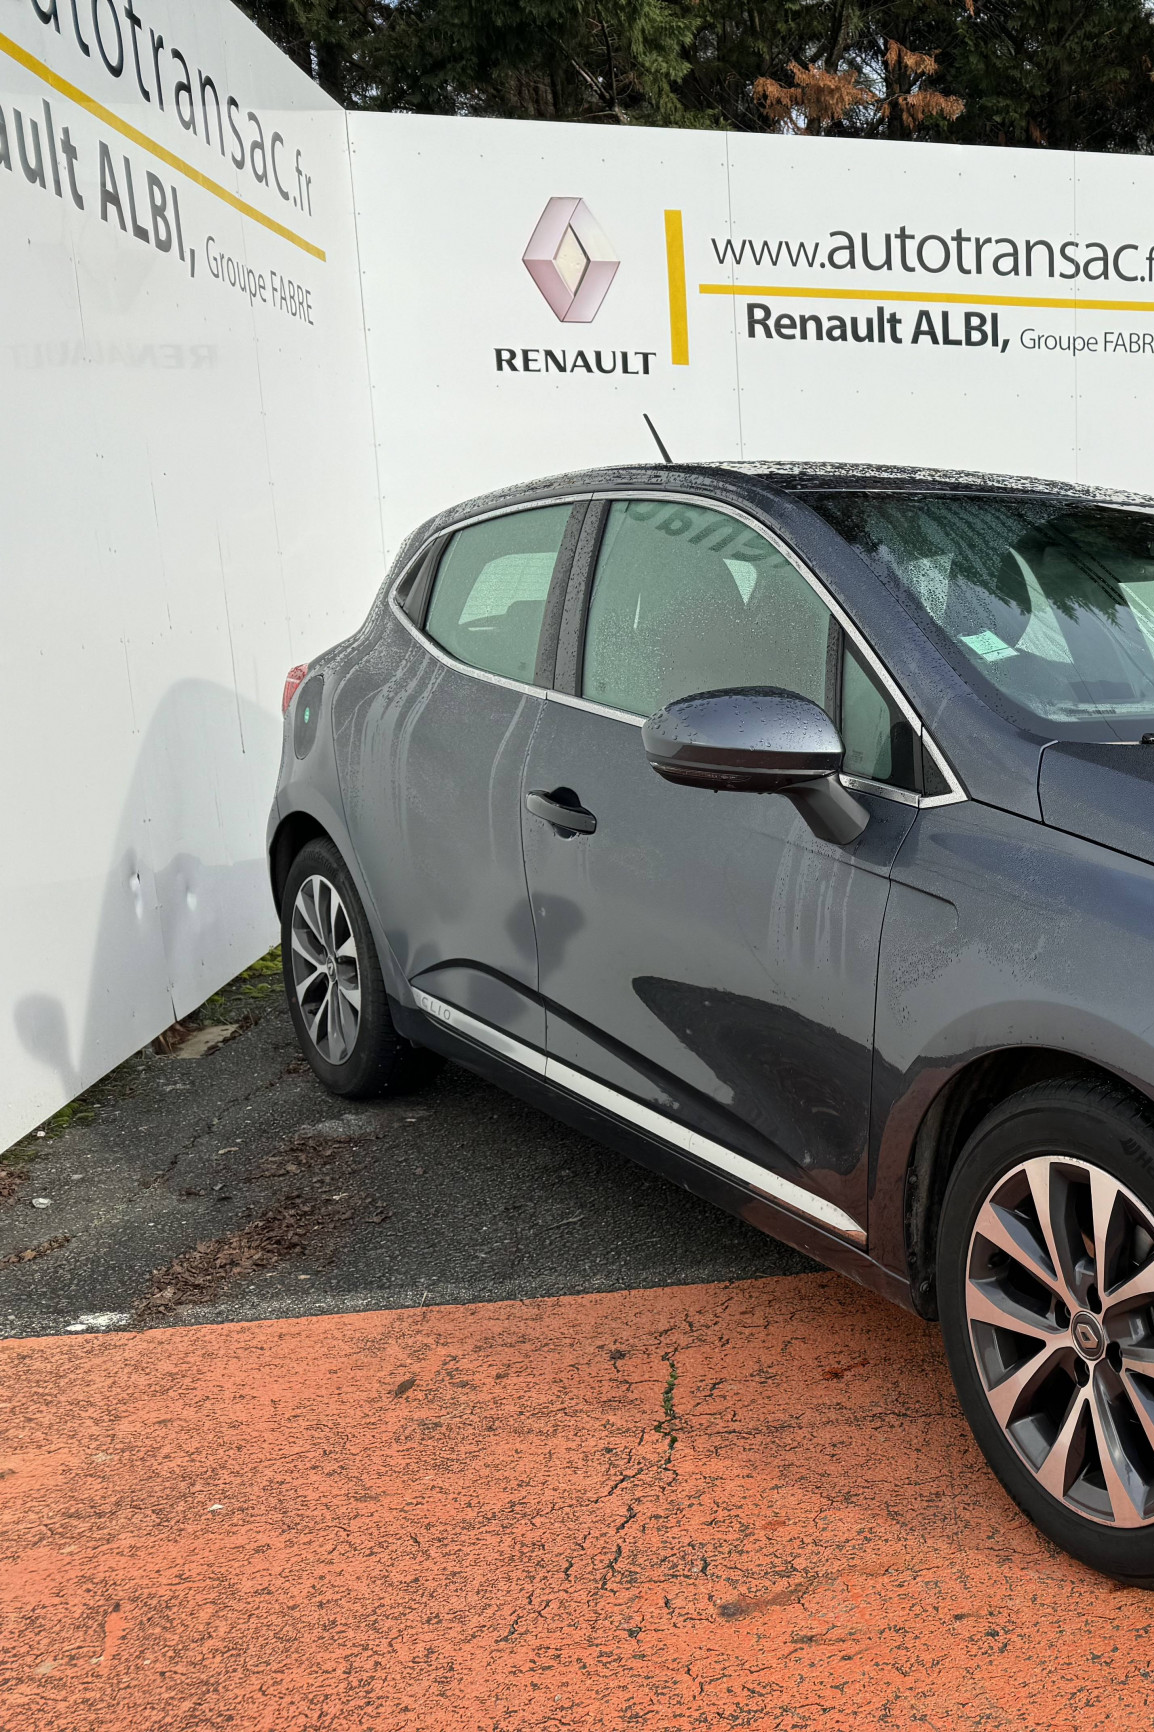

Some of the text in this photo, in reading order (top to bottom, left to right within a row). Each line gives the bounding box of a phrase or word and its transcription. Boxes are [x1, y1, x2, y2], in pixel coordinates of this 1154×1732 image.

[99, 139, 196, 279] ALBI,
[205, 235, 267, 307] Groupe
[269, 270, 315, 326] FABRE
[746, 303, 904, 345] Renault
[911, 309, 1010, 354] ALBI,
[1020, 328, 1099, 357] Groupe
[494, 348, 658, 375] RENAULT
[421, 996, 451, 1021] CLIO
